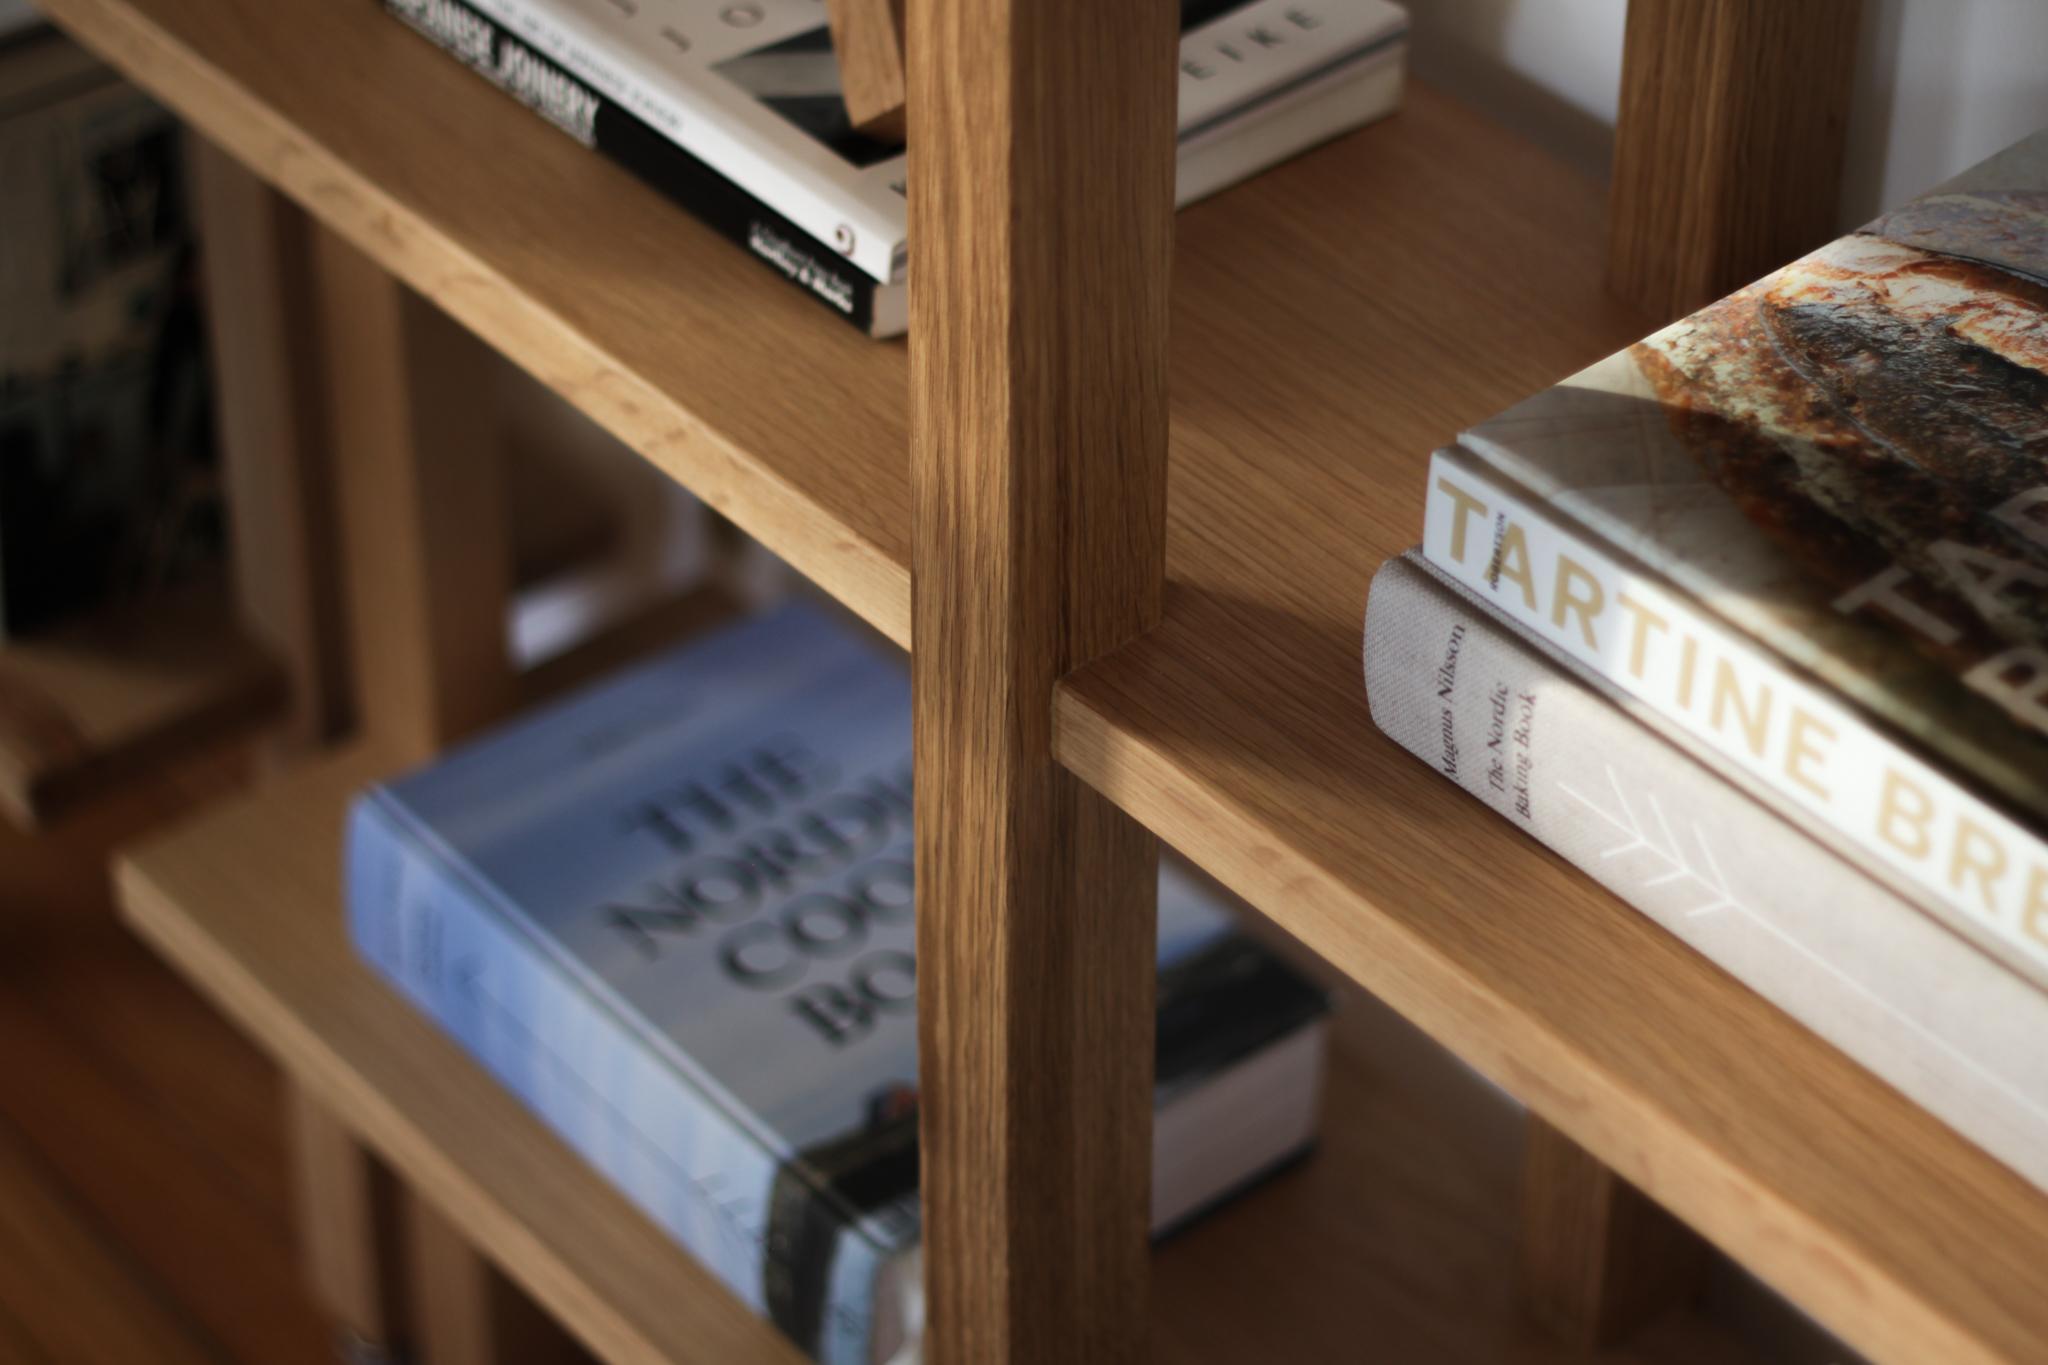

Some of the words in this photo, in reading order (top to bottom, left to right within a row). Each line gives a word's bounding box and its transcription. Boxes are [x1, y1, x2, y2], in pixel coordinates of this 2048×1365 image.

[1437, 475, 1839, 804] TARTINE
[1437, 624, 1466, 703] Nilsson
[1442, 706, 1460, 780] Magnus
[1487, 682, 1509, 755] Nordic
[1514, 691, 1537, 748] Book
[612, 745, 840, 852] THE
[1487, 758, 1505, 792] The
[1513, 754, 1534, 820] Baking
[788, 950, 914, 1046] BO
